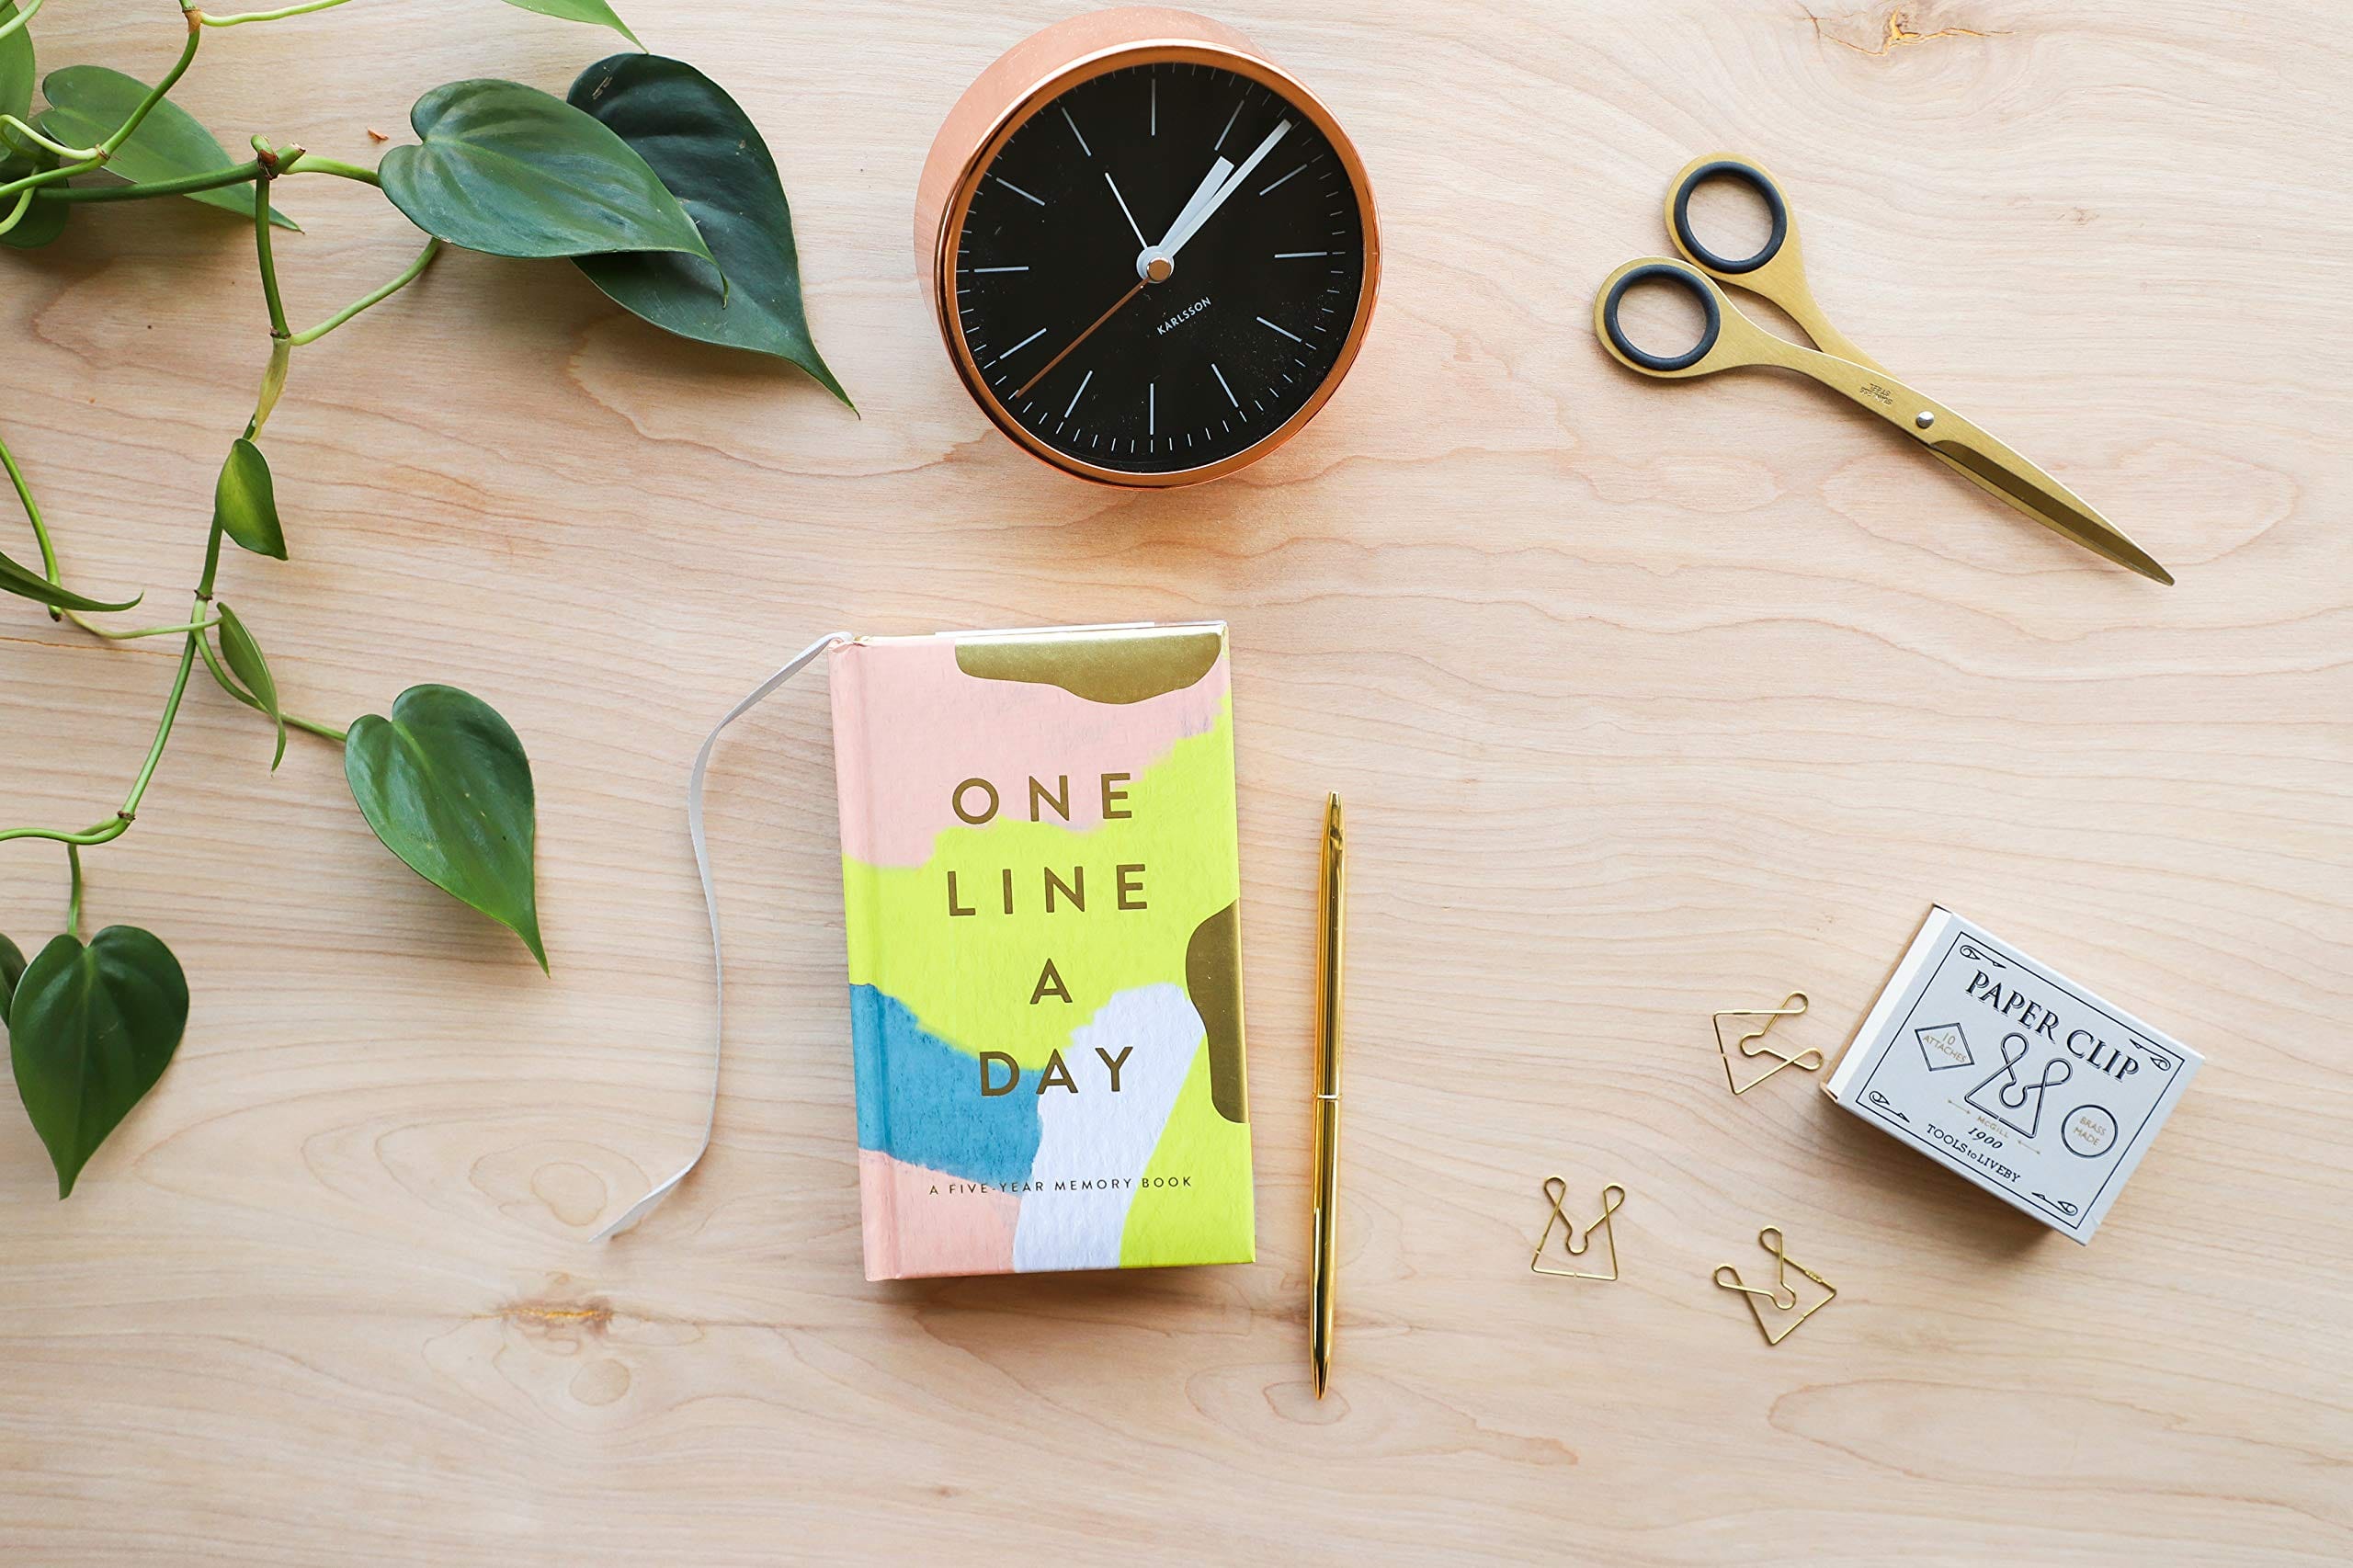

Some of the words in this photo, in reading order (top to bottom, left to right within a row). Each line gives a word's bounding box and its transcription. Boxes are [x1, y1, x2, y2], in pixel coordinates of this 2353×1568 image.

[1156, 296, 1211, 335] KARLSSON
[951, 772, 1132, 825] ONE
[948, 863, 1148, 916] LINE
[1029, 958, 1073, 1005] A
[1942, 1032, 1956, 1046] 10
[1965, 969, 2060, 1044] PAPER
[2066, 1028, 2140, 1083] CLIP
[1923, 1035, 1967, 1062] ATTACHES
[979, 1046, 1133, 1097] DAY
[1968, 1127, 2003, 1149] 1900
[2074, 1127, 2100, 1146] MADE
[2079, 1116, 2107, 1136] BRASS
[1927, 1123, 1968, 1153] TOOLS
[1967, 1149, 1977, 1160] to
[1977, 1153, 2021, 1183] LIVEBY
[929, 1185, 938, 1196] A
[949, 1181, 1043, 1194] FIVE-YEAR
[1054, 1178, 1131, 1191] MEMORY
[1142, 1176, 1191, 1188] BOOK
